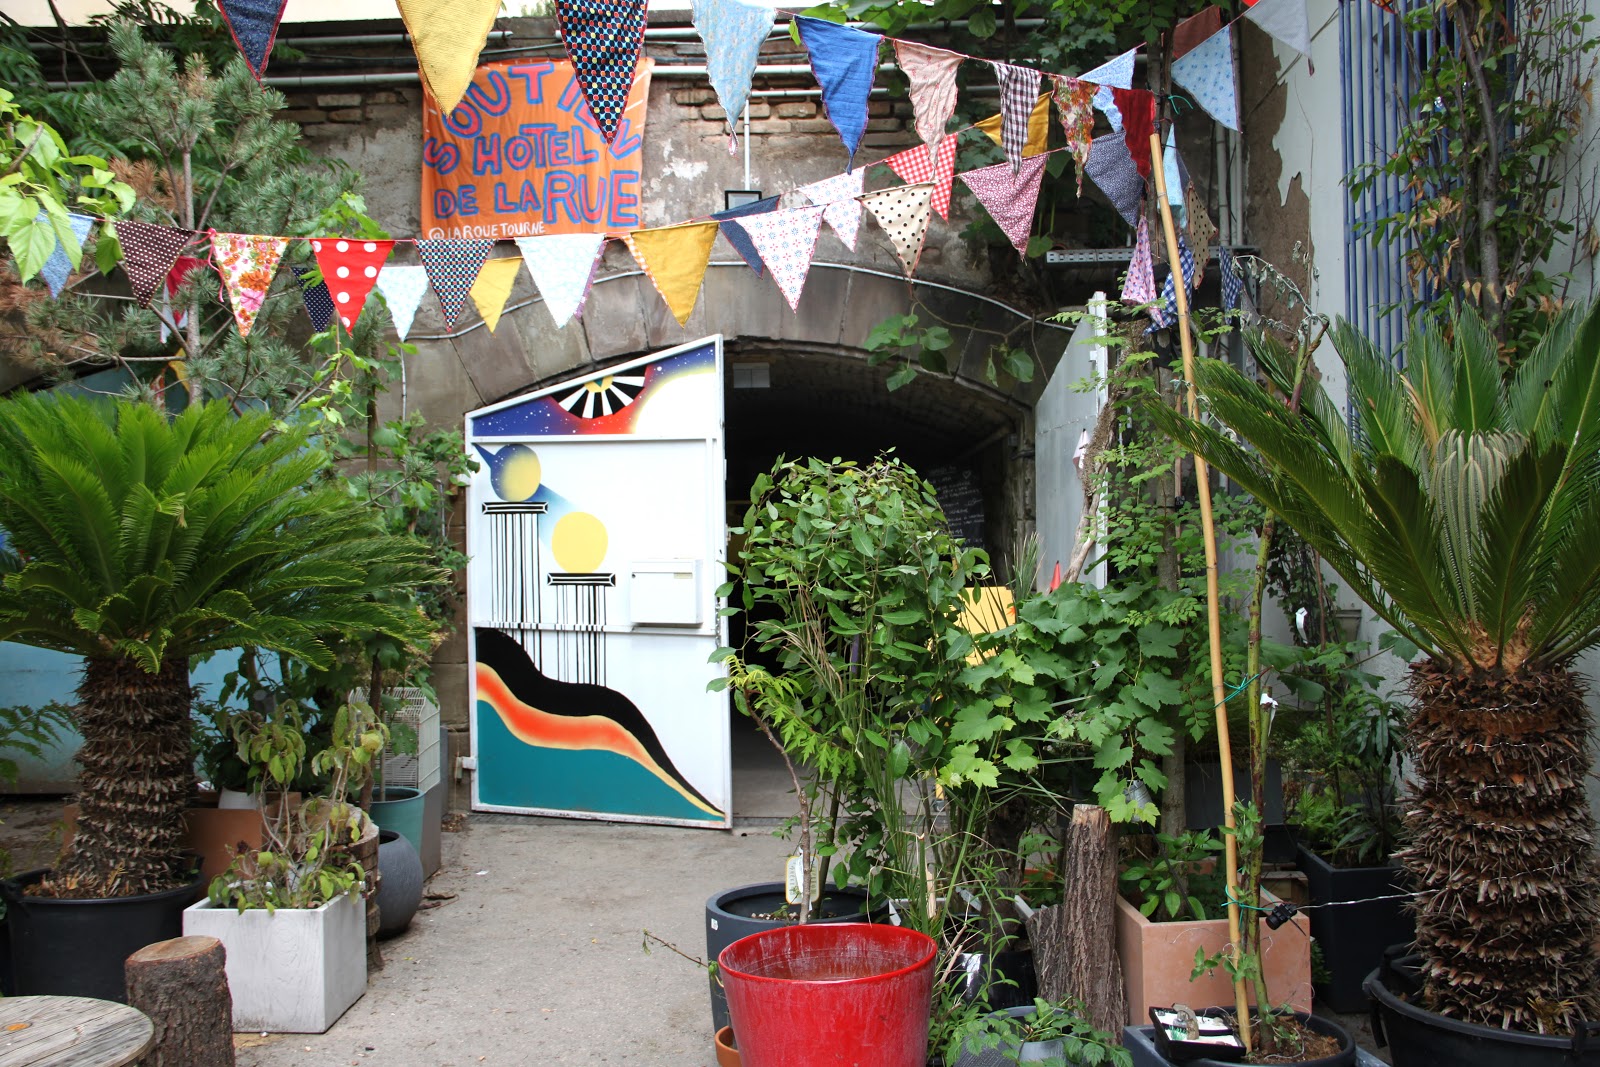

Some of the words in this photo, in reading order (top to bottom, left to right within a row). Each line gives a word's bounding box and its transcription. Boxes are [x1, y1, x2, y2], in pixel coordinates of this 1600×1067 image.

[472, 123, 599, 176] HOTEL
[434, 184, 479, 219] DE
[494, 179, 541, 214] LA
[543, 170, 639, 227] RUE
